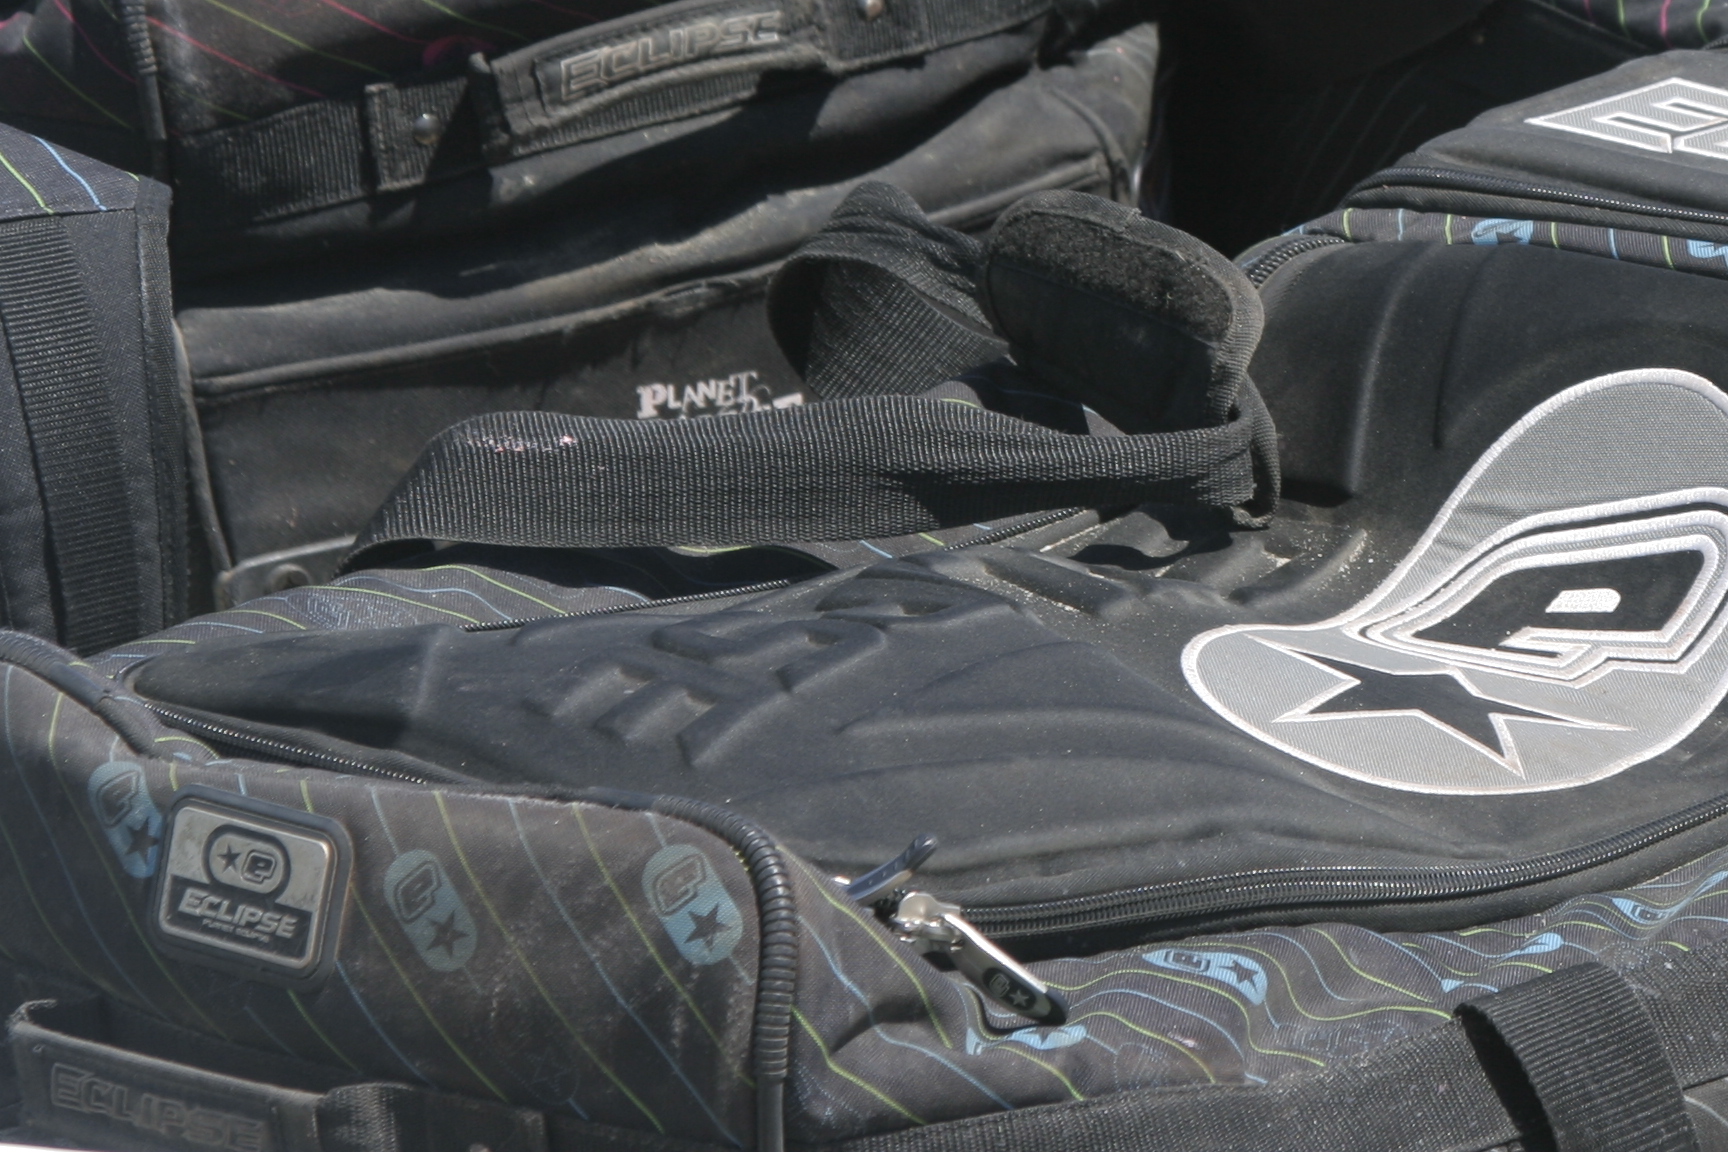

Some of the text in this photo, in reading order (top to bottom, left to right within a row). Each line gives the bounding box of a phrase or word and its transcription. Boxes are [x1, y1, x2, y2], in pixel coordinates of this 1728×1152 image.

[560, 11, 784, 101] ECLIPSE
[636, 370, 758, 420] PLANET
[177, 887, 299, 939] ECLIPSE
